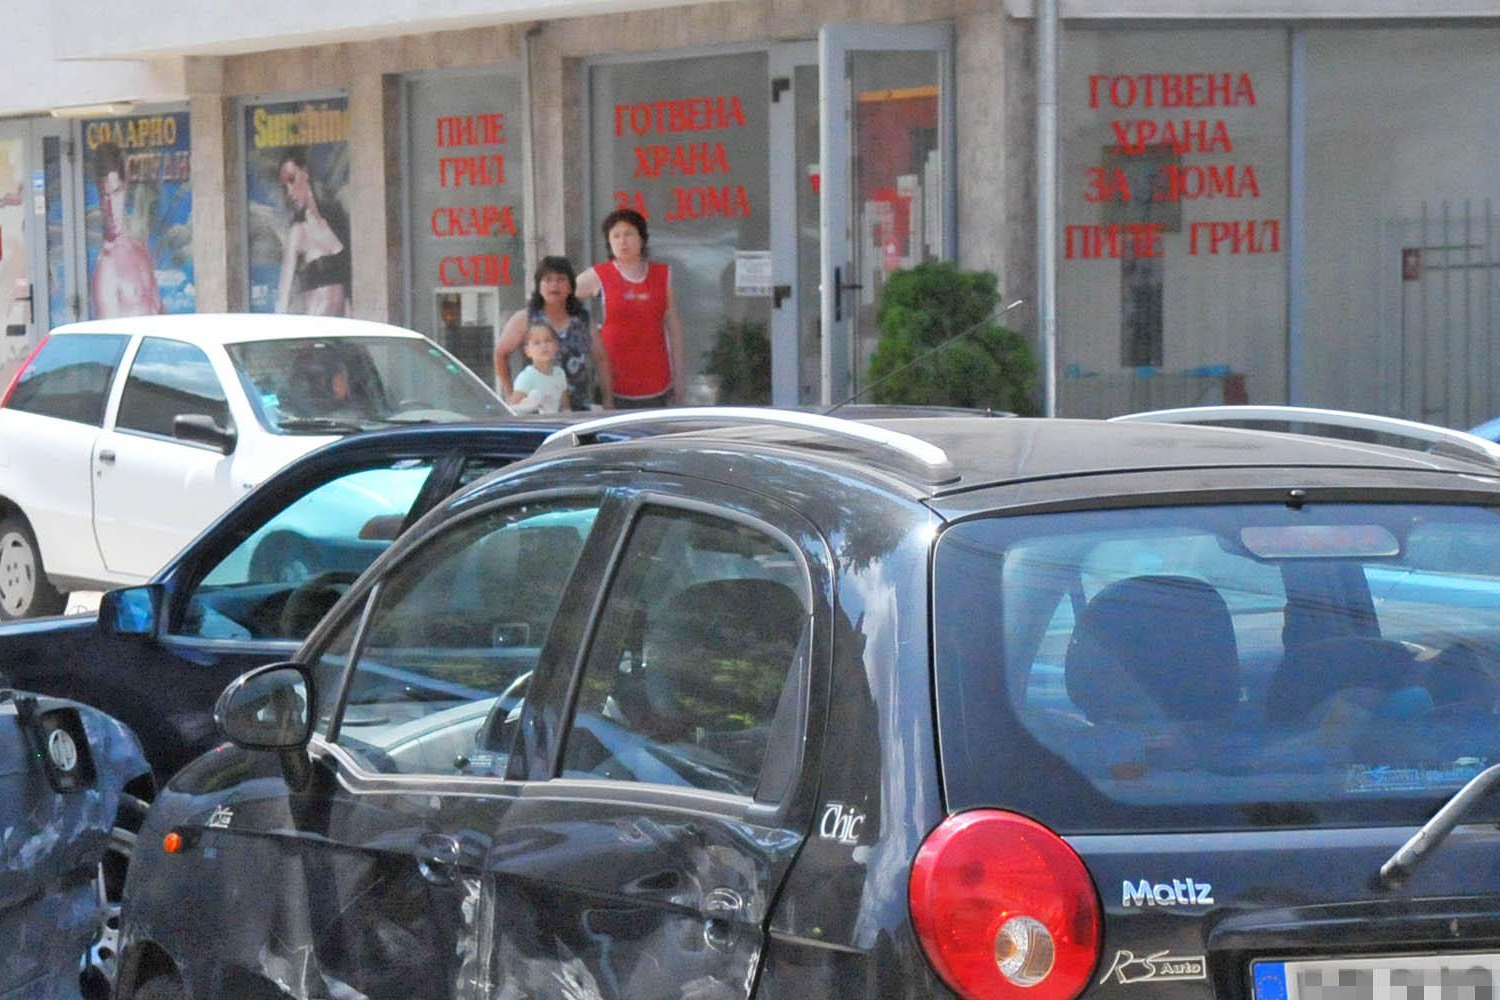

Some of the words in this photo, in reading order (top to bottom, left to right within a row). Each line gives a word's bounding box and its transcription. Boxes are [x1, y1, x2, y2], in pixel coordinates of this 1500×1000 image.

[1088, 73, 1257, 109] ГОТВЕНА
[87, 116, 177, 149] СОЛАРНО
[436, 113, 505, 147] ПИЛЕ
[614, 96, 746, 137] ГОТВЕНА
[1108, 119, 1234, 155] ХРАНА
[439, 155, 505, 188] ГРИЛ
[633, 143, 730, 178] ХРАНА
[1085, 166, 1131, 202] ЗА
[1155, 164, 1261, 202] ДОМА
[432, 205, 516, 237] СКАРА
[666, 185, 751, 222] ДОМА
[1064, 223, 1166, 260] ПИЛЕ
[1189, 219, 1280, 256] ГРИЛ
[438, 255, 511, 287] СУПИ
[820, 803, 867, 845] Chic
[1122, 877, 1215, 907] Matiz
[1160, 961, 1202, 976] Auto
